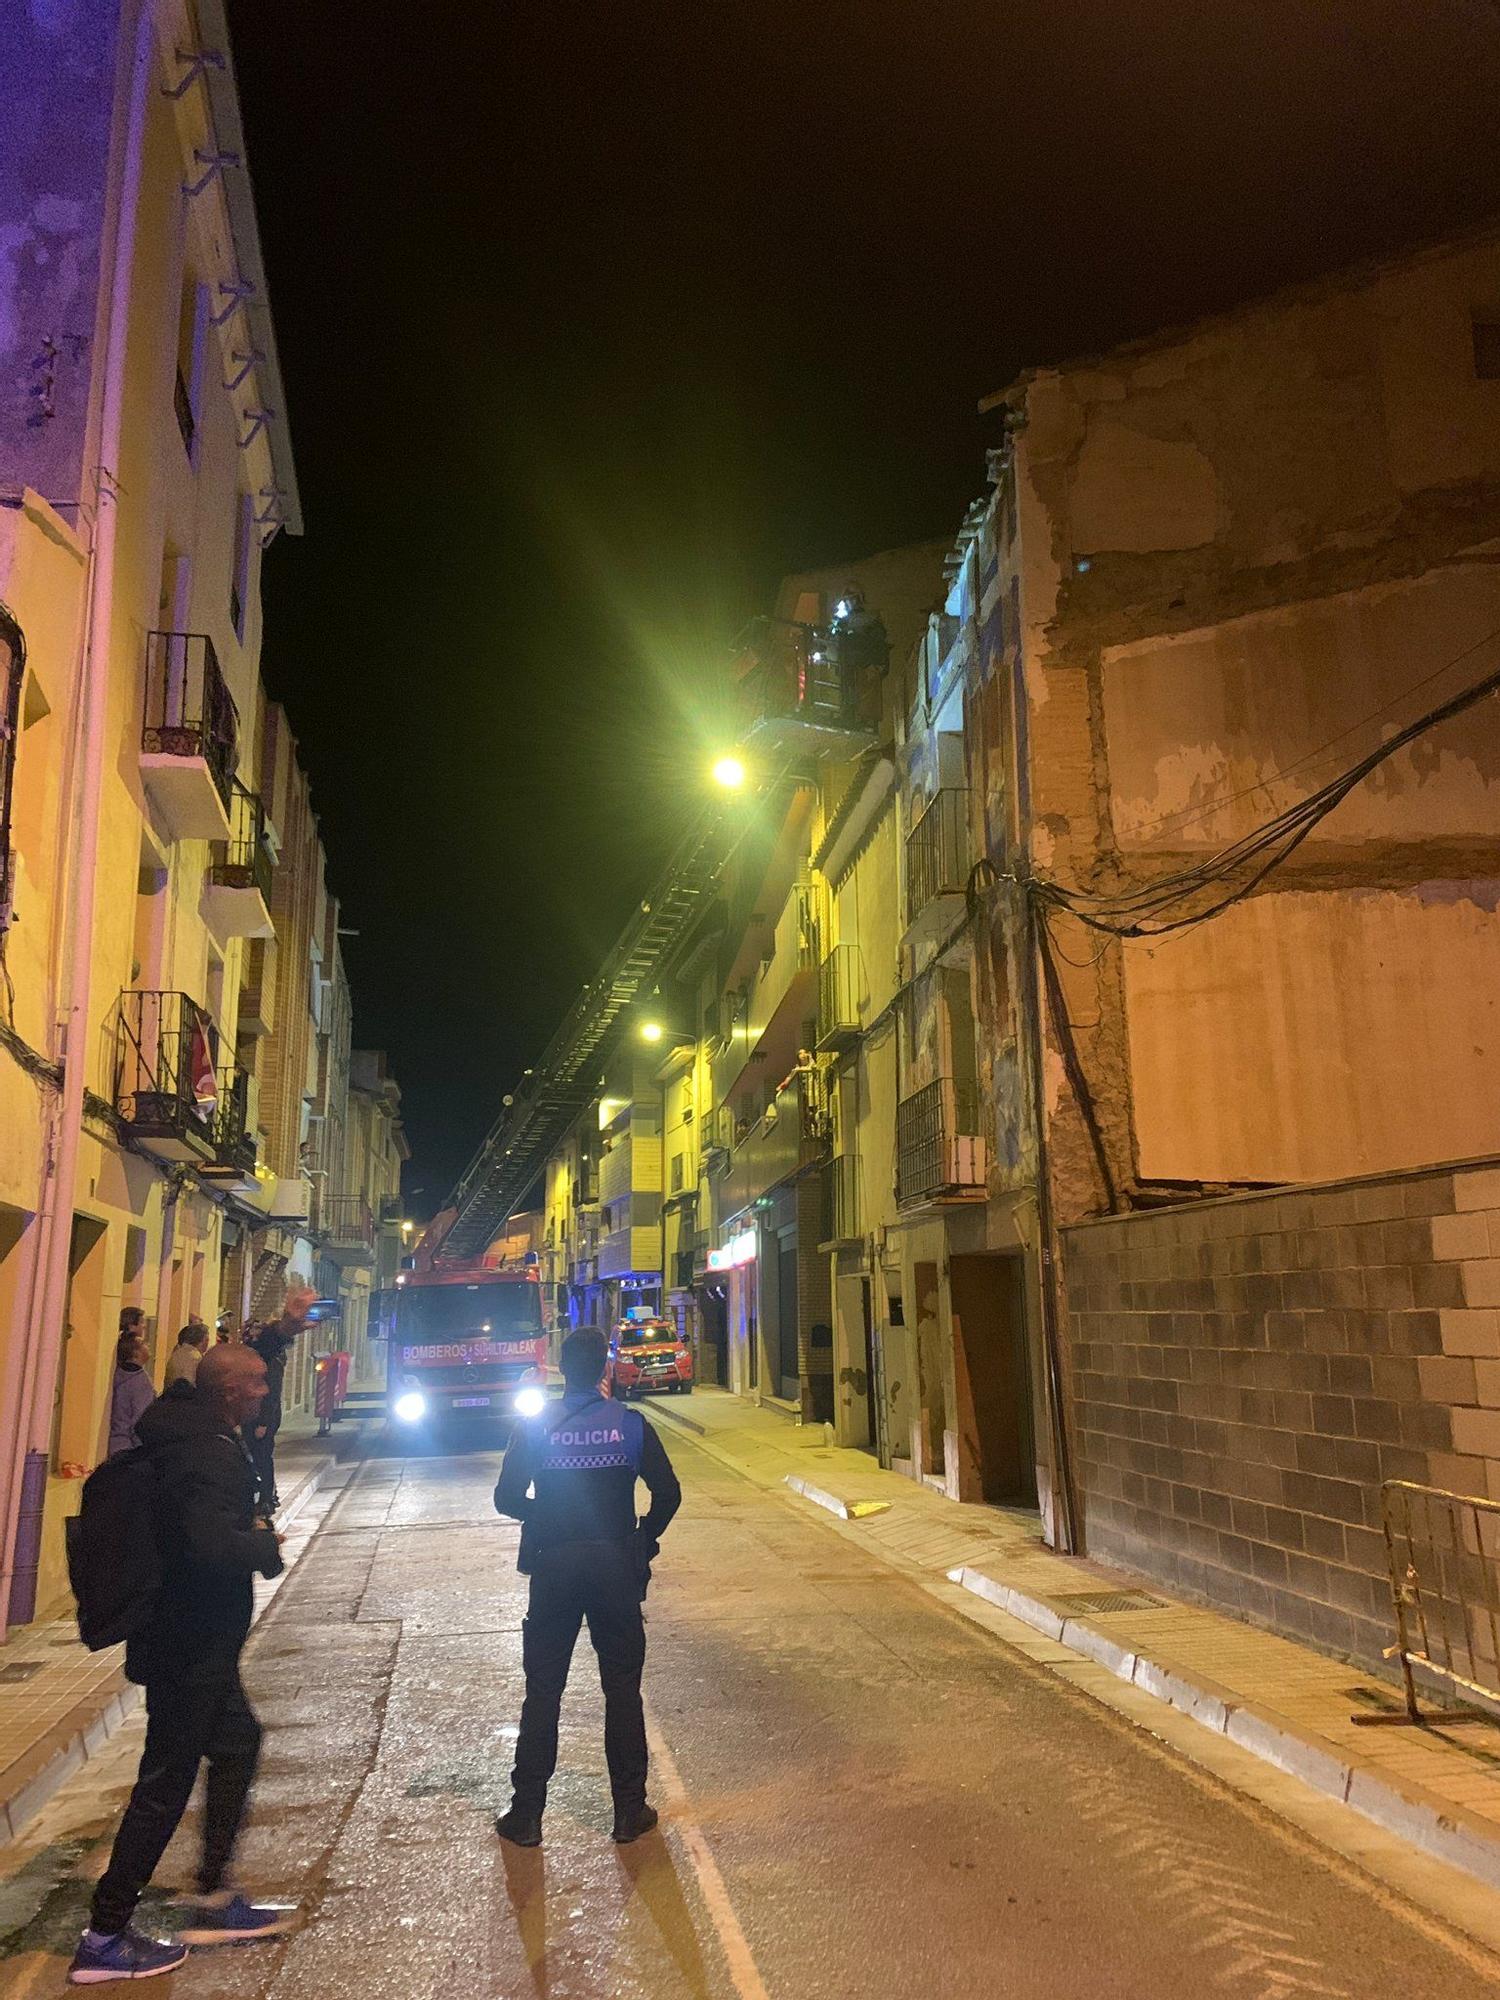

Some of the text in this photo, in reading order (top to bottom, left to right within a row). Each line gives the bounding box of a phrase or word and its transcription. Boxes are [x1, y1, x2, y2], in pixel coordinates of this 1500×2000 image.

[403, 1340, 536, 1360] BOMBEROS SUHILTZAILEAK
[550, 1429, 620, 1446] POLICIA
